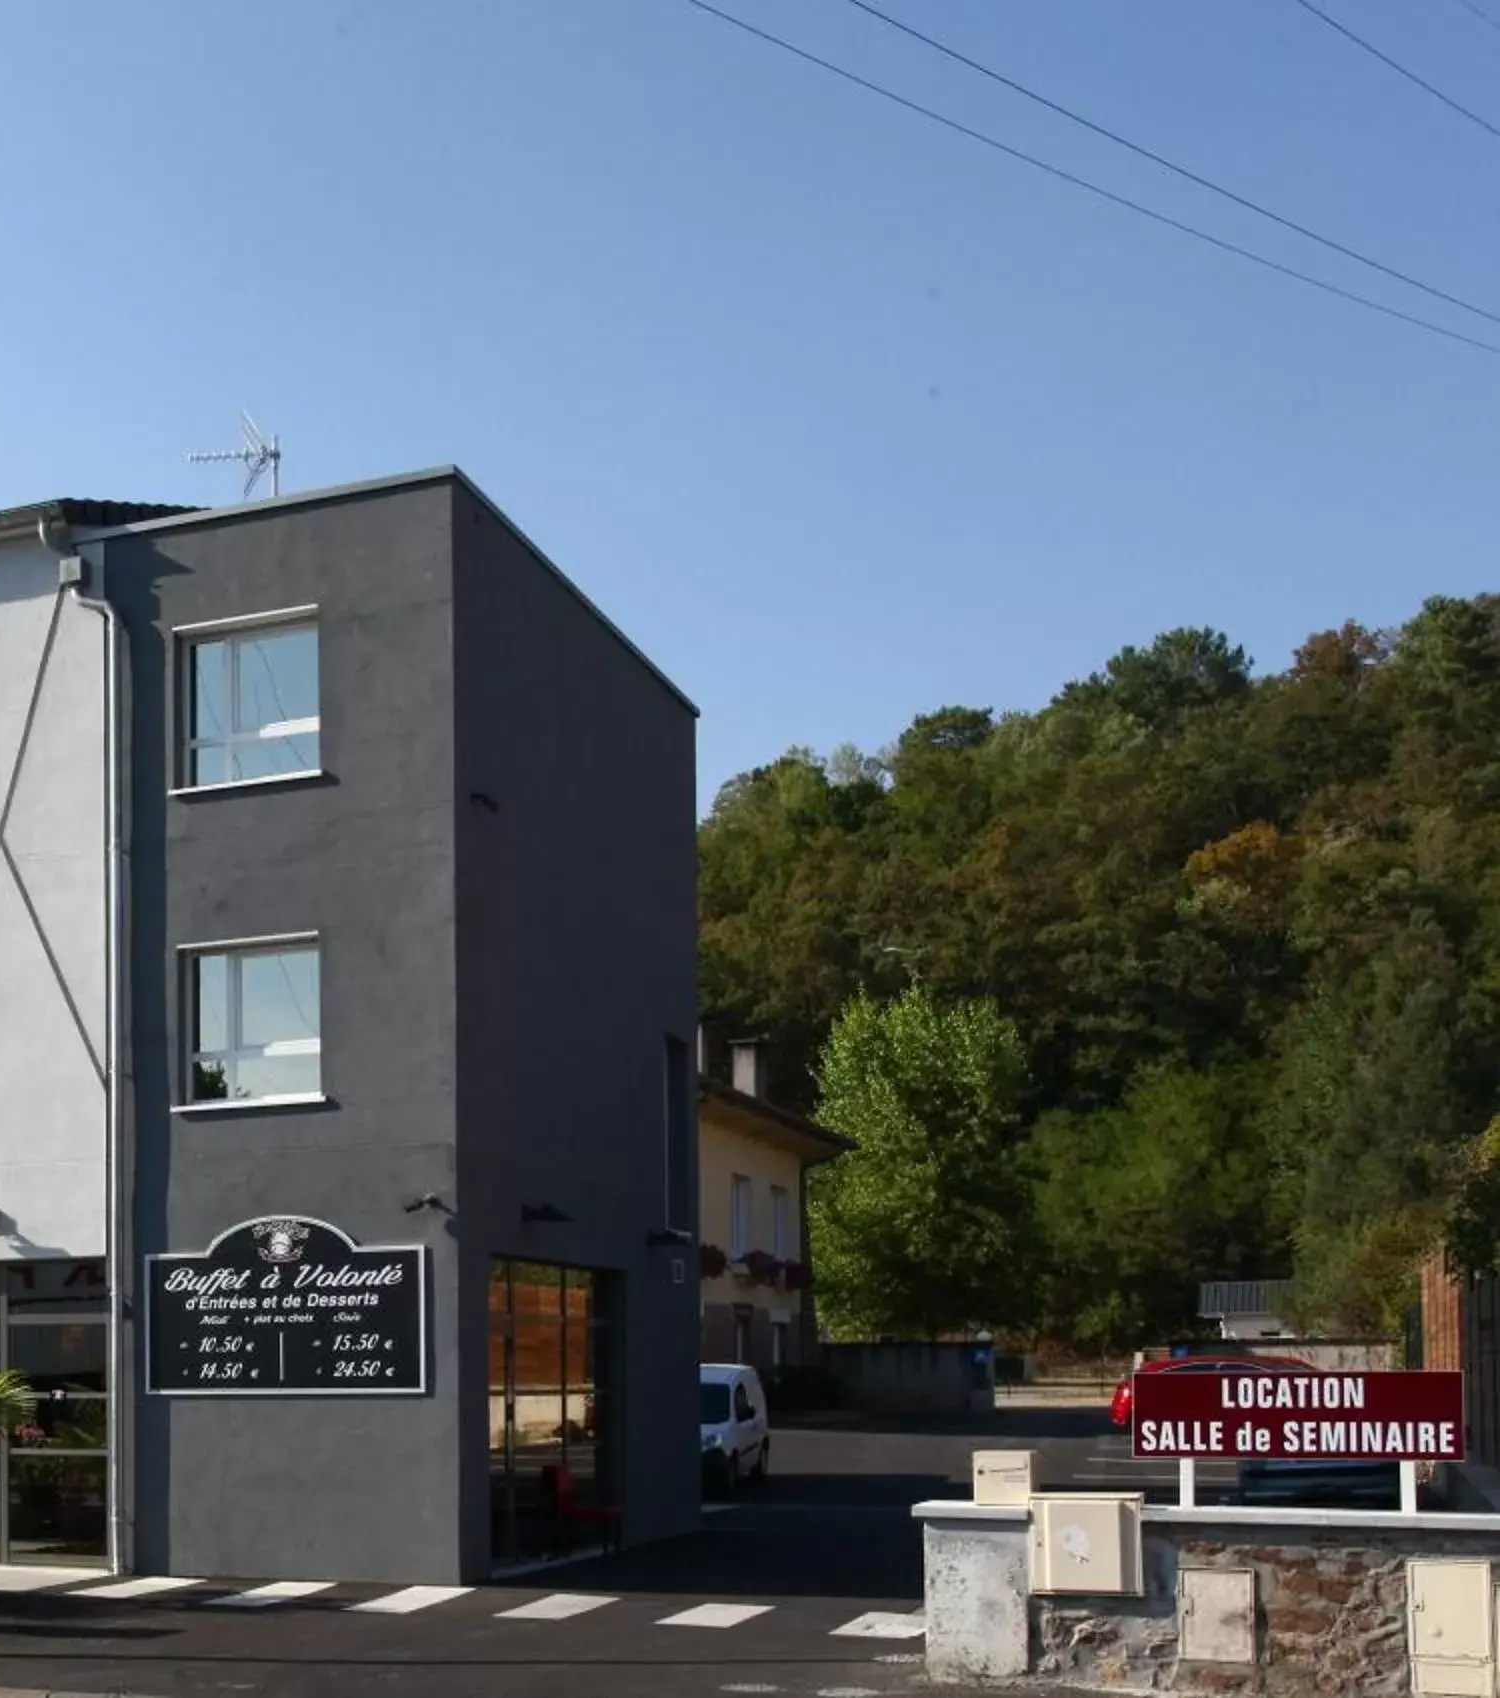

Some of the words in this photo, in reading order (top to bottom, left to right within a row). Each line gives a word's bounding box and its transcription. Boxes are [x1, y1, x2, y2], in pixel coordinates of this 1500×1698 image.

[164, 1267, 251, 1295] Buffet
[261, 1265, 281, 1289] à
[293, 1263, 403, 1288] Volonté
[185, 1294, 257, 1310] d'Entrées
[262, 1295, 277, 1309] et
[282, 1294, 301, 1308] de
[307, 1291, 379, 1307] Desserts
[200, 1336, 243, 1353] 10.50
[333, 1333, 380, 1351] 15.50
[200, 1363, 243, 1379] 14.50
[333, 1361, 381, 1377] 24.50
[1221, 1377, 1365, 1409] LOCATION
[1141, 1420, 1224, 1451] SALLE
[1236, 1422, 1271, 1451] de
[1283, 1421, 1456, 1454] SEMINAIRE
